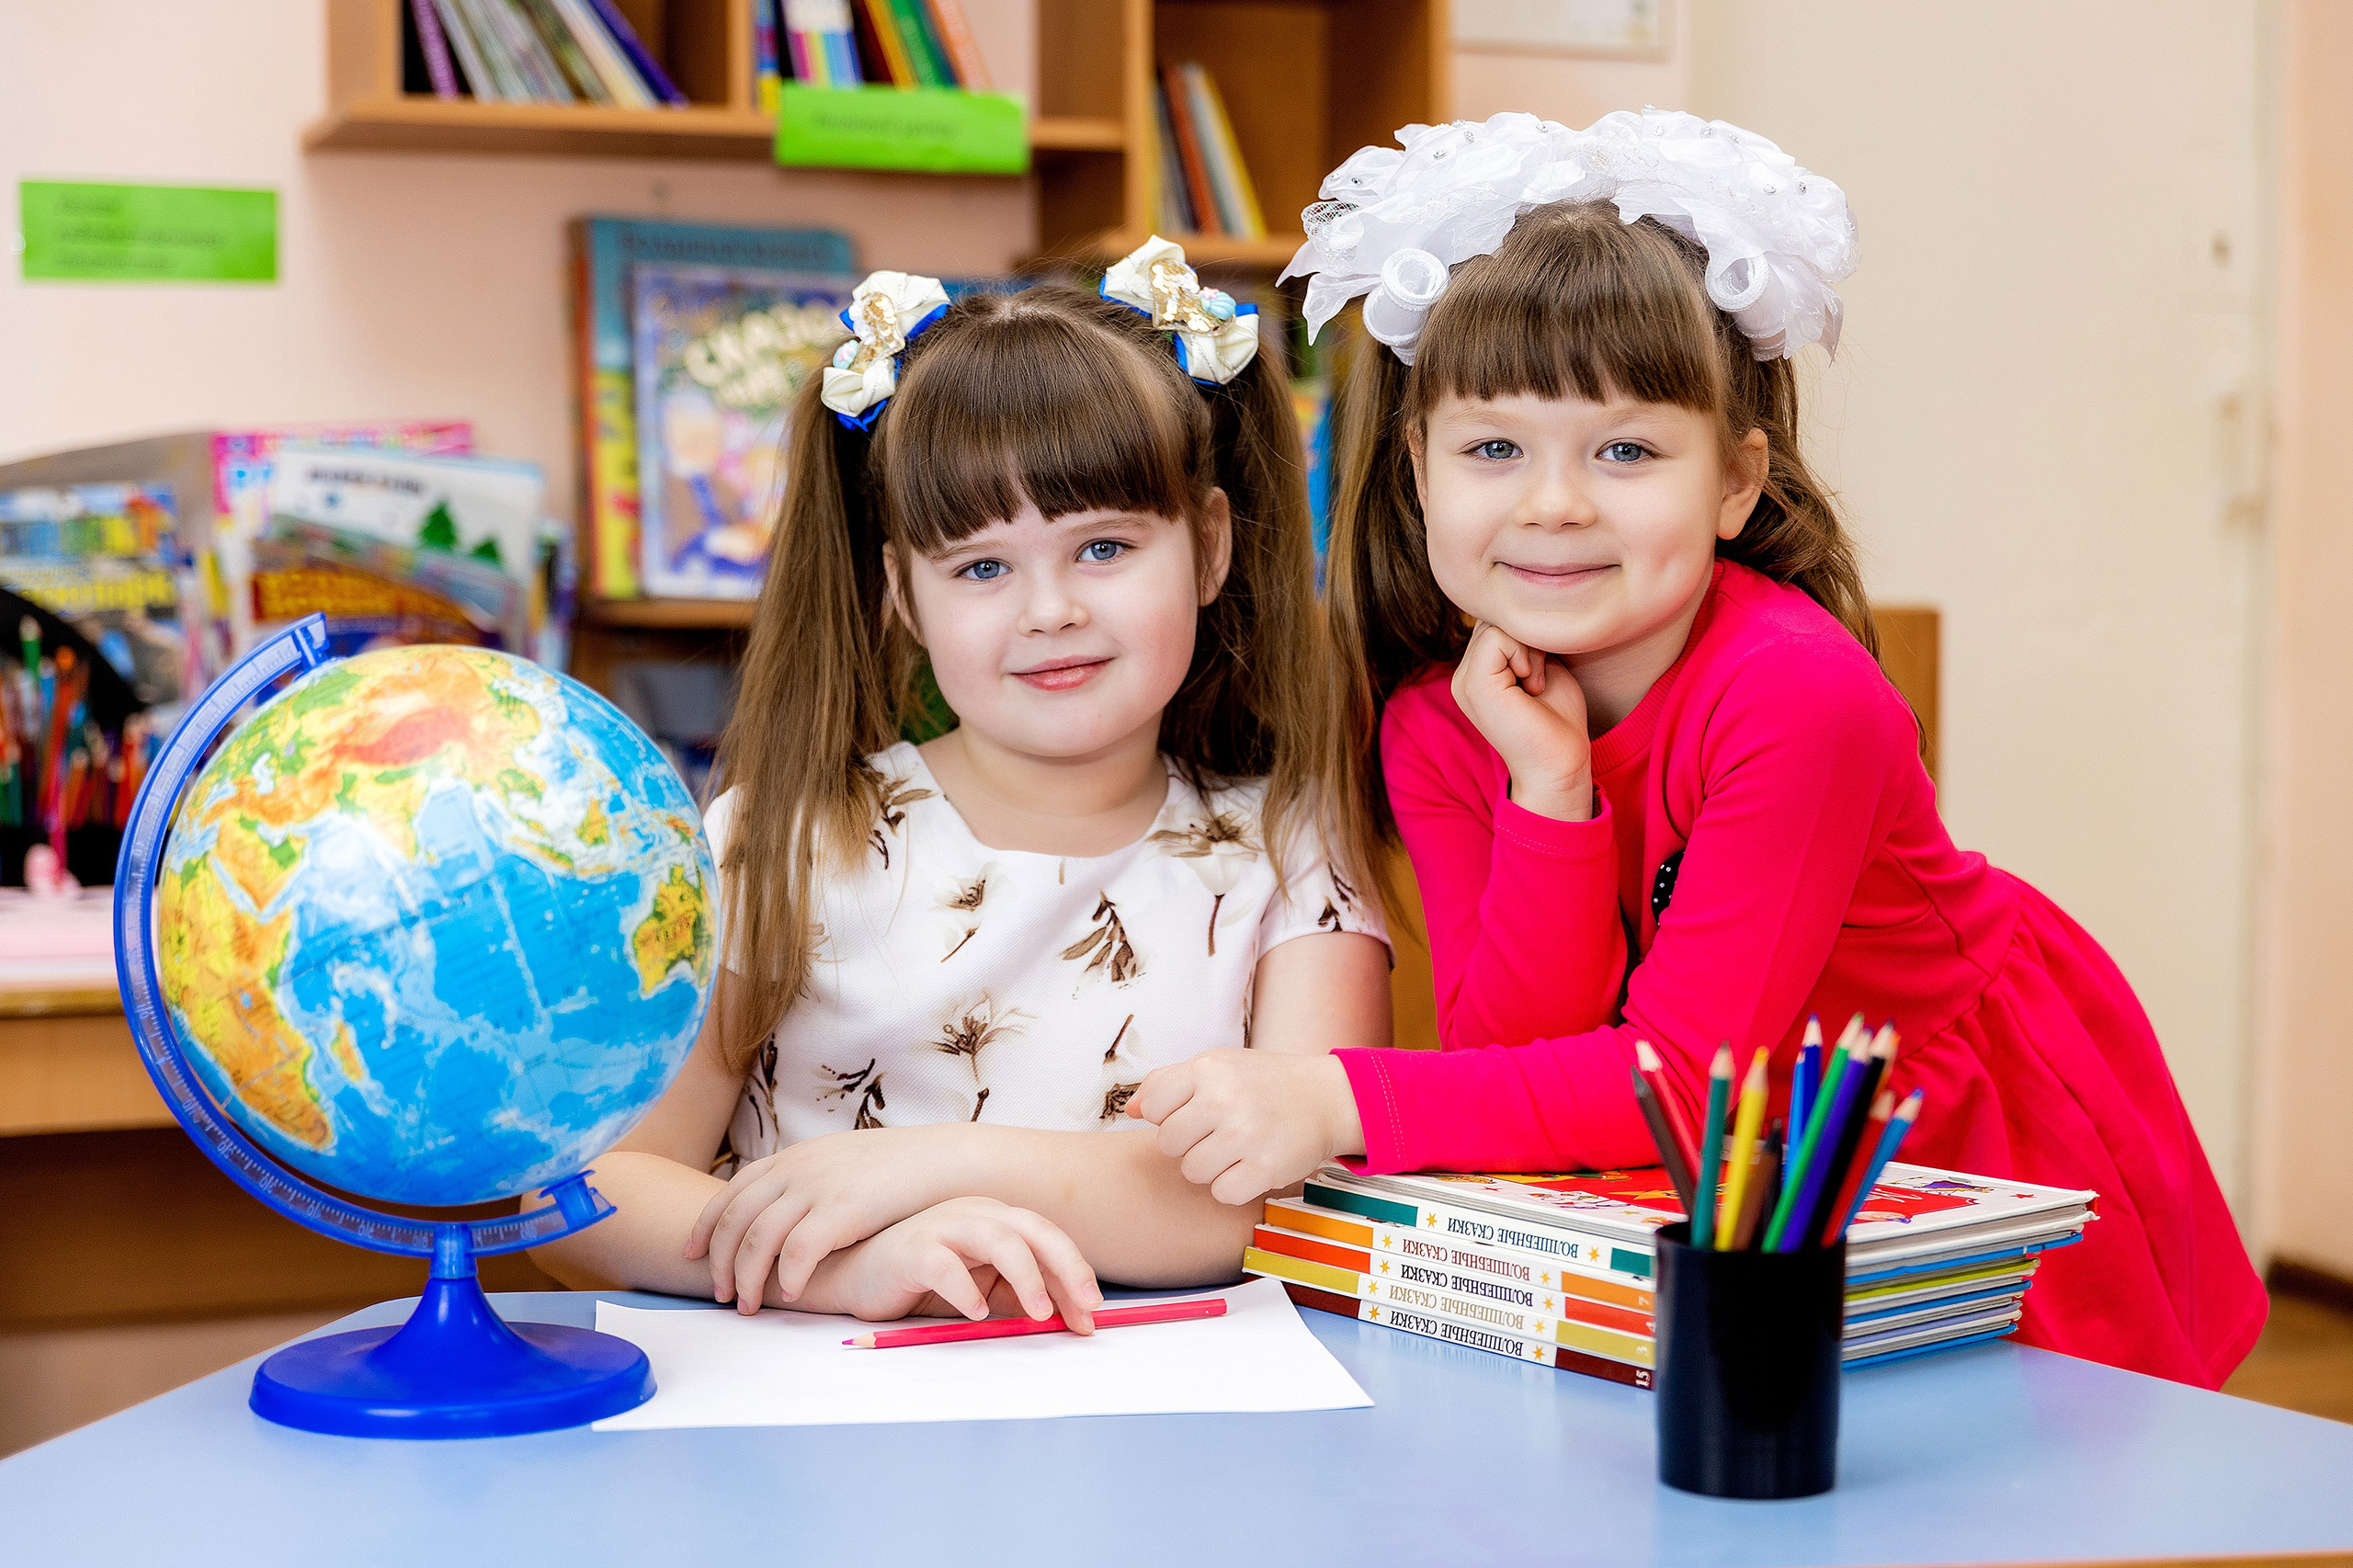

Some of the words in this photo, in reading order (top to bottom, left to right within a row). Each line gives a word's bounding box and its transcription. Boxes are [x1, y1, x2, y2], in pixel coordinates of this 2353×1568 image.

[1447, 1217, 1495, 1241] СКАЗКИ
[1403, 1238, 1448, 1262] СКАЗКИ
[1496, 1228, 1579, 1258] ВОЛШЕБНЫЕ
[1401, 1264, 1448, 1288] СКАЗКИ
[1450, 1249, 1530, 1281] ВОЛШЕБНЫЕ
[1389, 1284, 1438, 1309] СКАЗКИ
[1450, 1276, 1533, 1307] ВОЛШЕБНЫЕ
[1389, 1310, 1438, 1335] СКАЗКИ
[1440, 1297, 1524, 1330] ВОЛШЕБНЫЕ
[1440, 1323, 1524, 1357] ВОЛШЕБНЫЕ
[1635, 1369, 1651, 1388] 15
